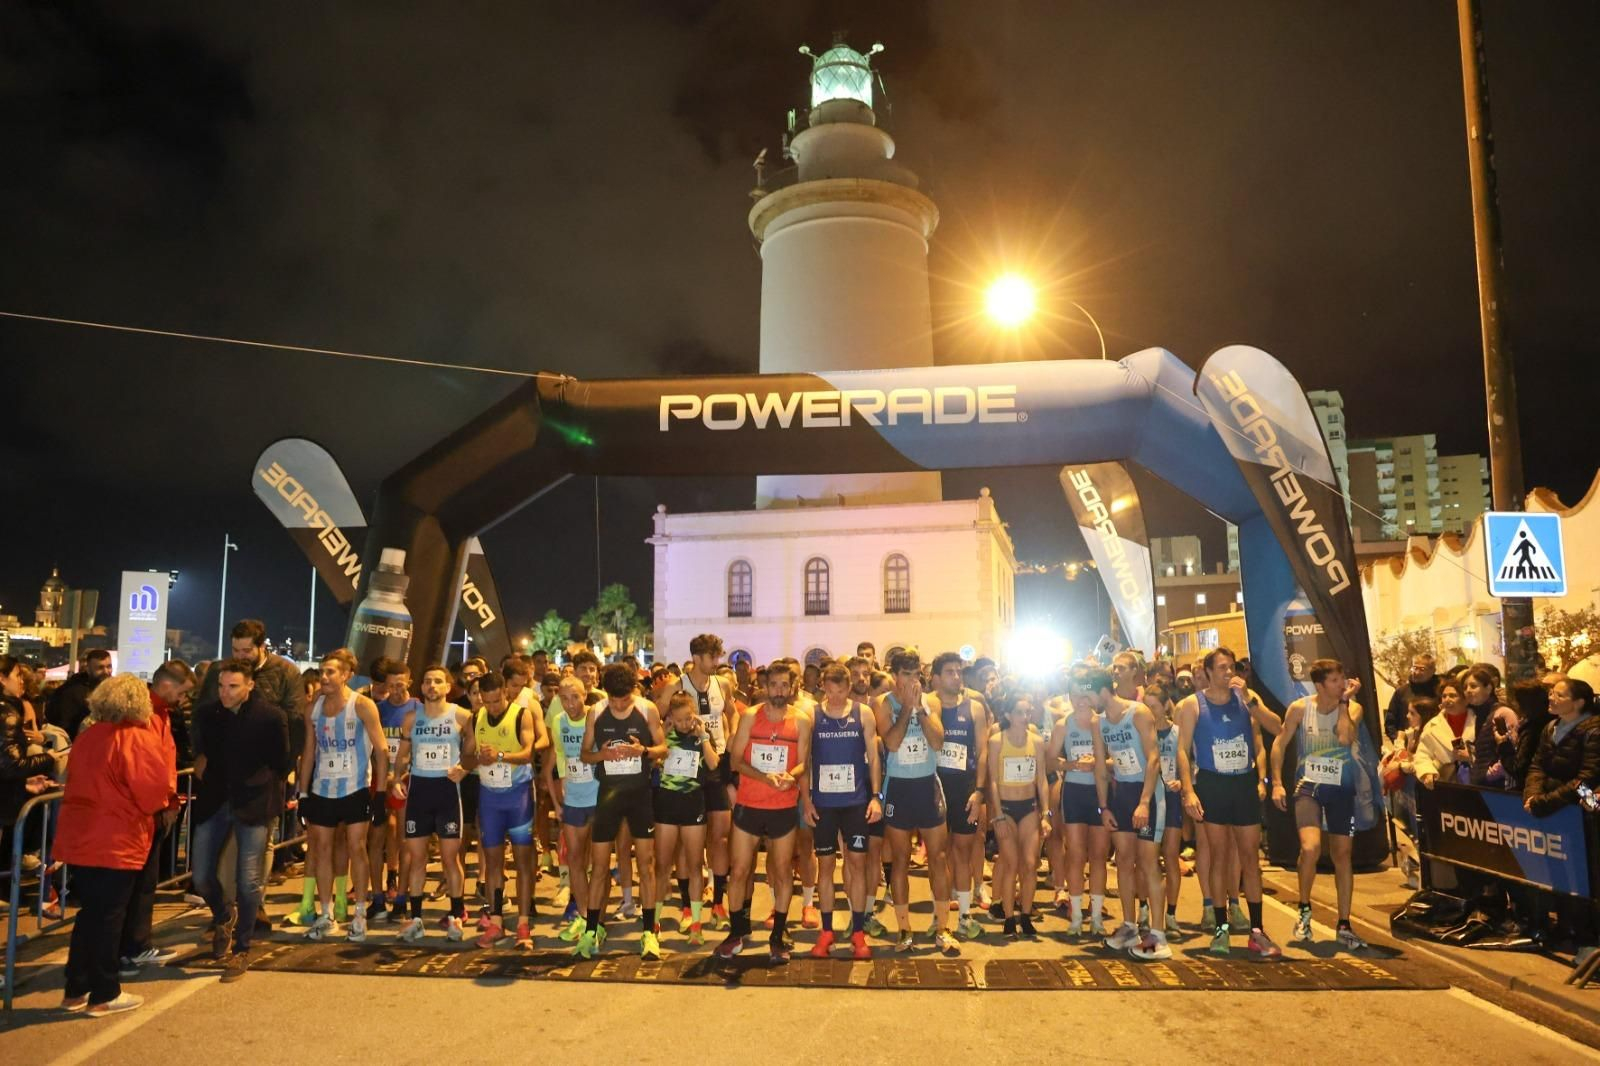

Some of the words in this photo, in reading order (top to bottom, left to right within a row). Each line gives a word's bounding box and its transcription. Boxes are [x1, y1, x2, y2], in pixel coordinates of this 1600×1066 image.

[659, 385, 1017, 431] POWERADE
[352, 622, 410, 639] OWERADE
[1286, 624, 1325, 635] POWE
[416, 724, 451, 737] nerja
[1103, 730, 1132, 743] nerja
[907, 744, 918, 752] 12
[760, 753, 773, 761] 16
[1219, 751, 1242, 759] 1284
[328, 760, 334, 768] 8
[1017, 764, 1021, 772] 1
[1310, 763, 1334, 774] 1196
[828, 773, 840, 781] 14
[1441, 812, 1563, 859] POWERADE
